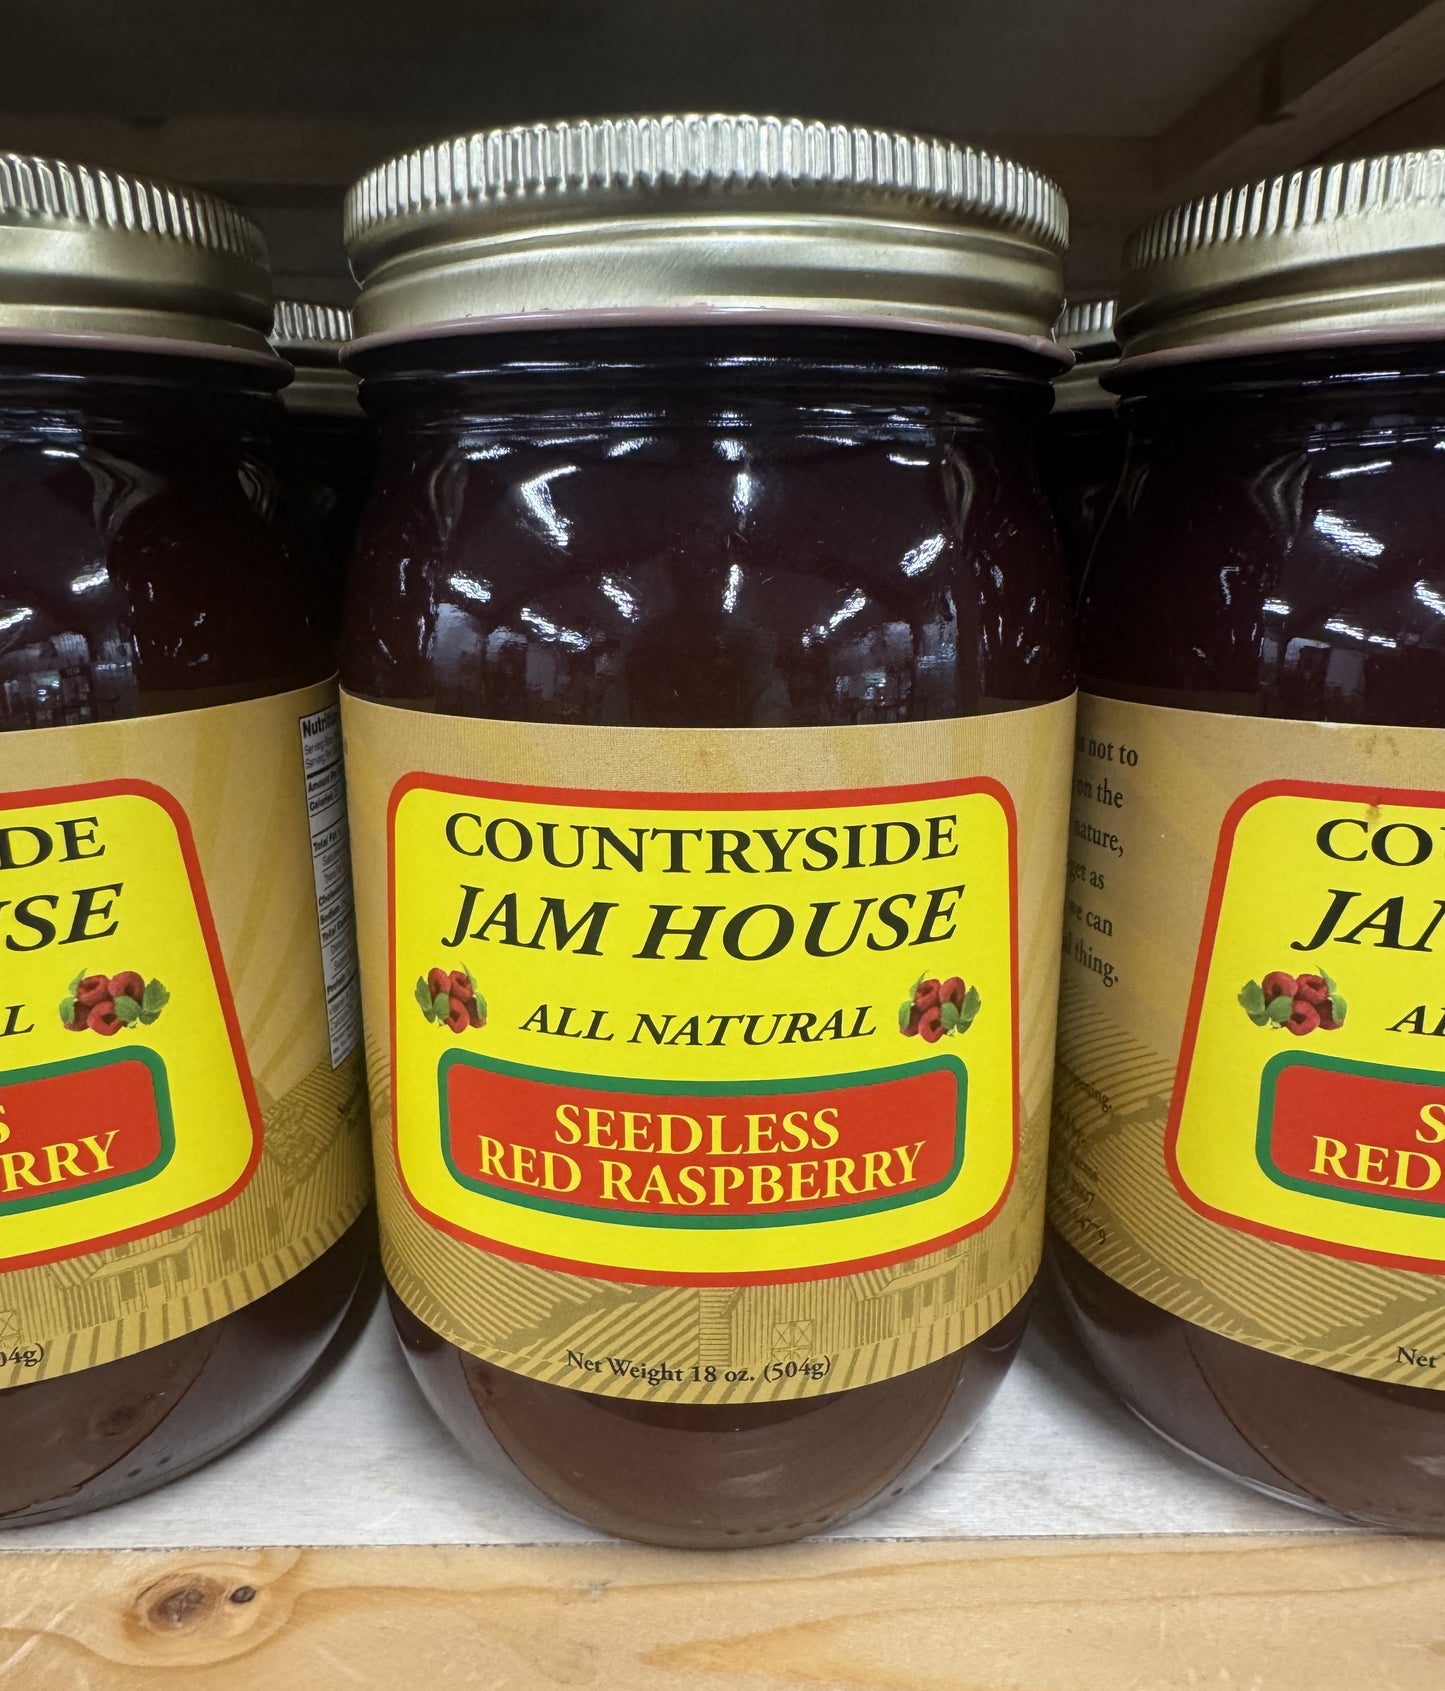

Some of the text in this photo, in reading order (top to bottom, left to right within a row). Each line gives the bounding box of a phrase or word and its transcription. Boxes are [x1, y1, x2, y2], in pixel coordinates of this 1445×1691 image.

[1088, 739, 1114, 761] not
[1119, 744, 1138, 766] to
[1097, 778, 1123, 809] the
[445, 812, 959, 874] COUNTRYSIDE
[1071, 819, 1124, 857] nature,
[1316, 818, 1445, 866] CO
[1089, 871, 1104, 890] as
[0, 882, 124, 952] SE
[441, 884, 966, 962] JAM HOUSE
[1086, 911, 1113, 937] can
[1075, 938, 1119, 987] thing.
[518, 1003, 877, 1047] ALL NATURAL
[554, 1103, 840, 1156] SEEDLESS
[478, 1135, 928, 1206] RED RASPBERRY
[1309, 1135, 1442, 1191] RED
[567, 1350, 832, 1387] Net Weight 18 oz. (504g)
[1397, 1346, 1437, 1369] Net
